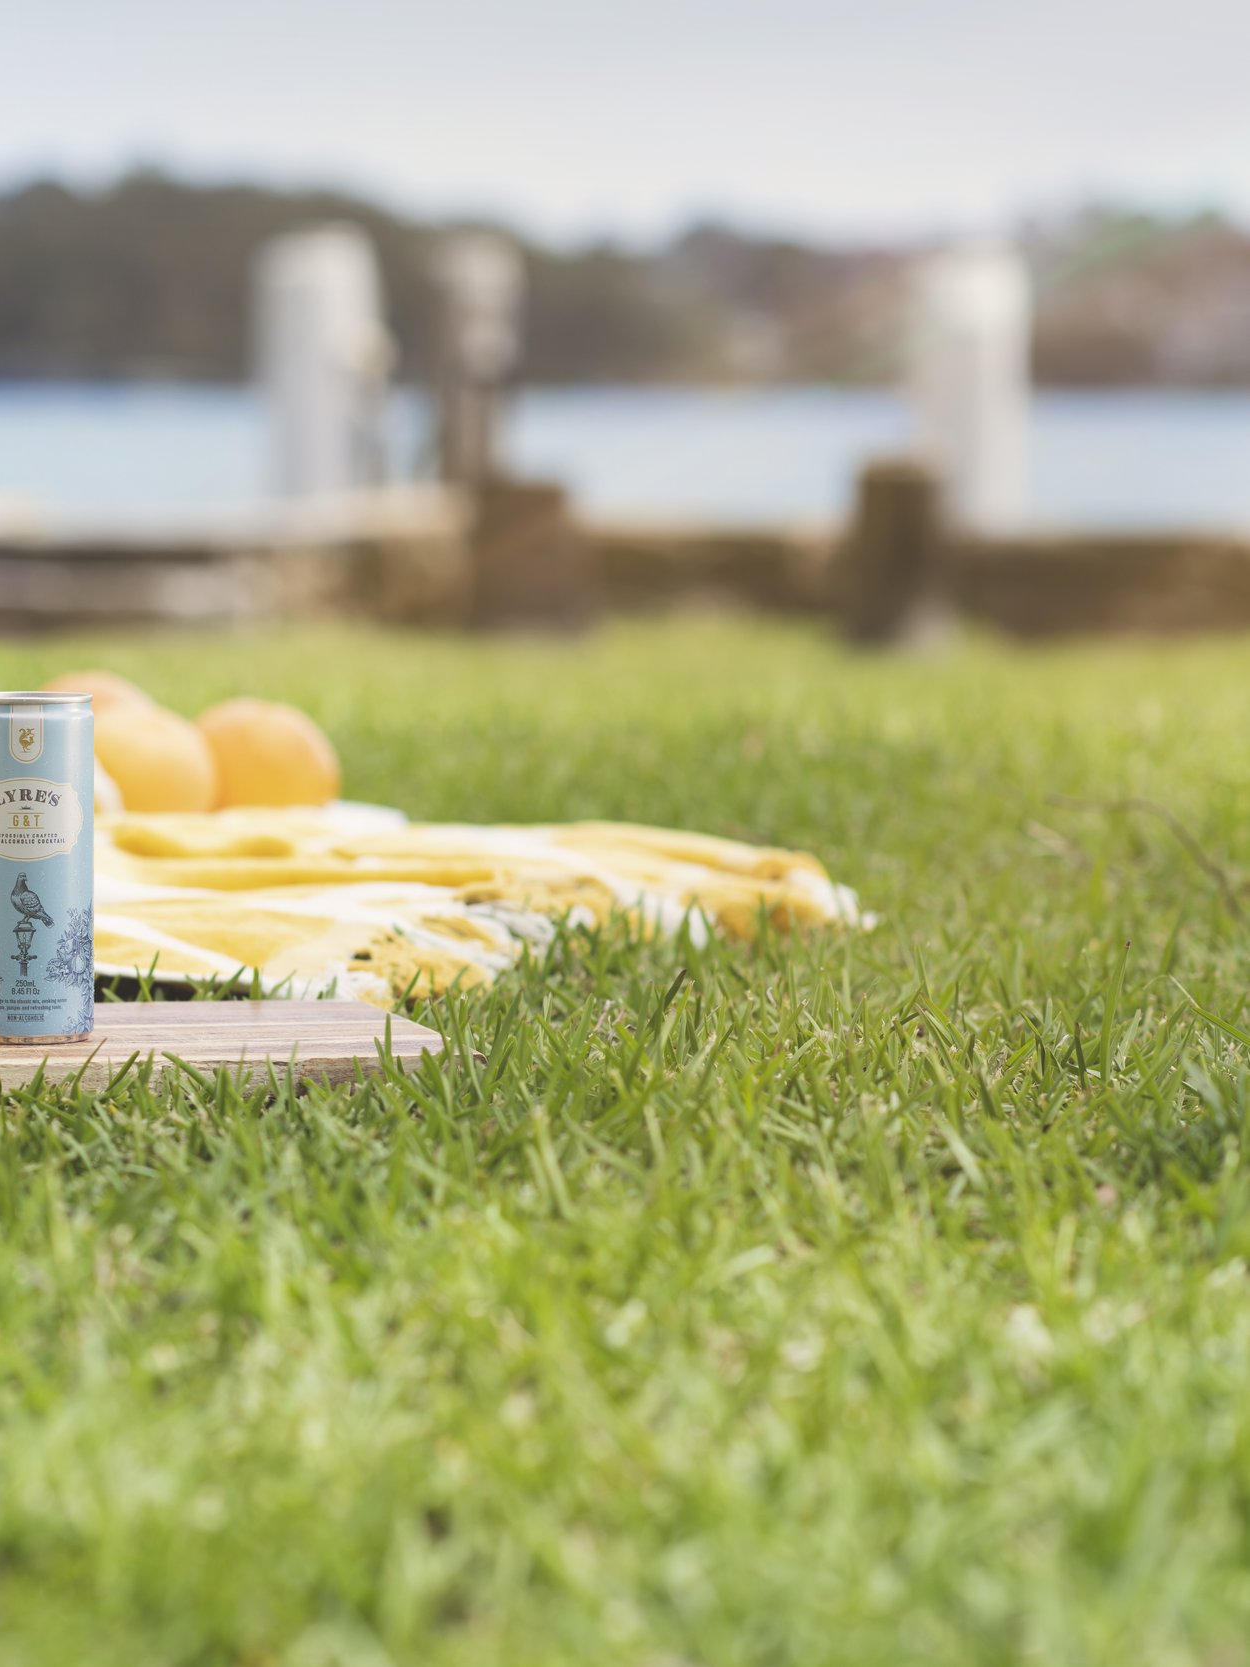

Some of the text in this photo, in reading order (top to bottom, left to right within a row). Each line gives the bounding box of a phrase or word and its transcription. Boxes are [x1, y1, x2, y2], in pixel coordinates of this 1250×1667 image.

[13, 814, 40, 827] G & T
[15, 979, 36, 988] 250mL
[11, 988, 25, 996] 8.45
